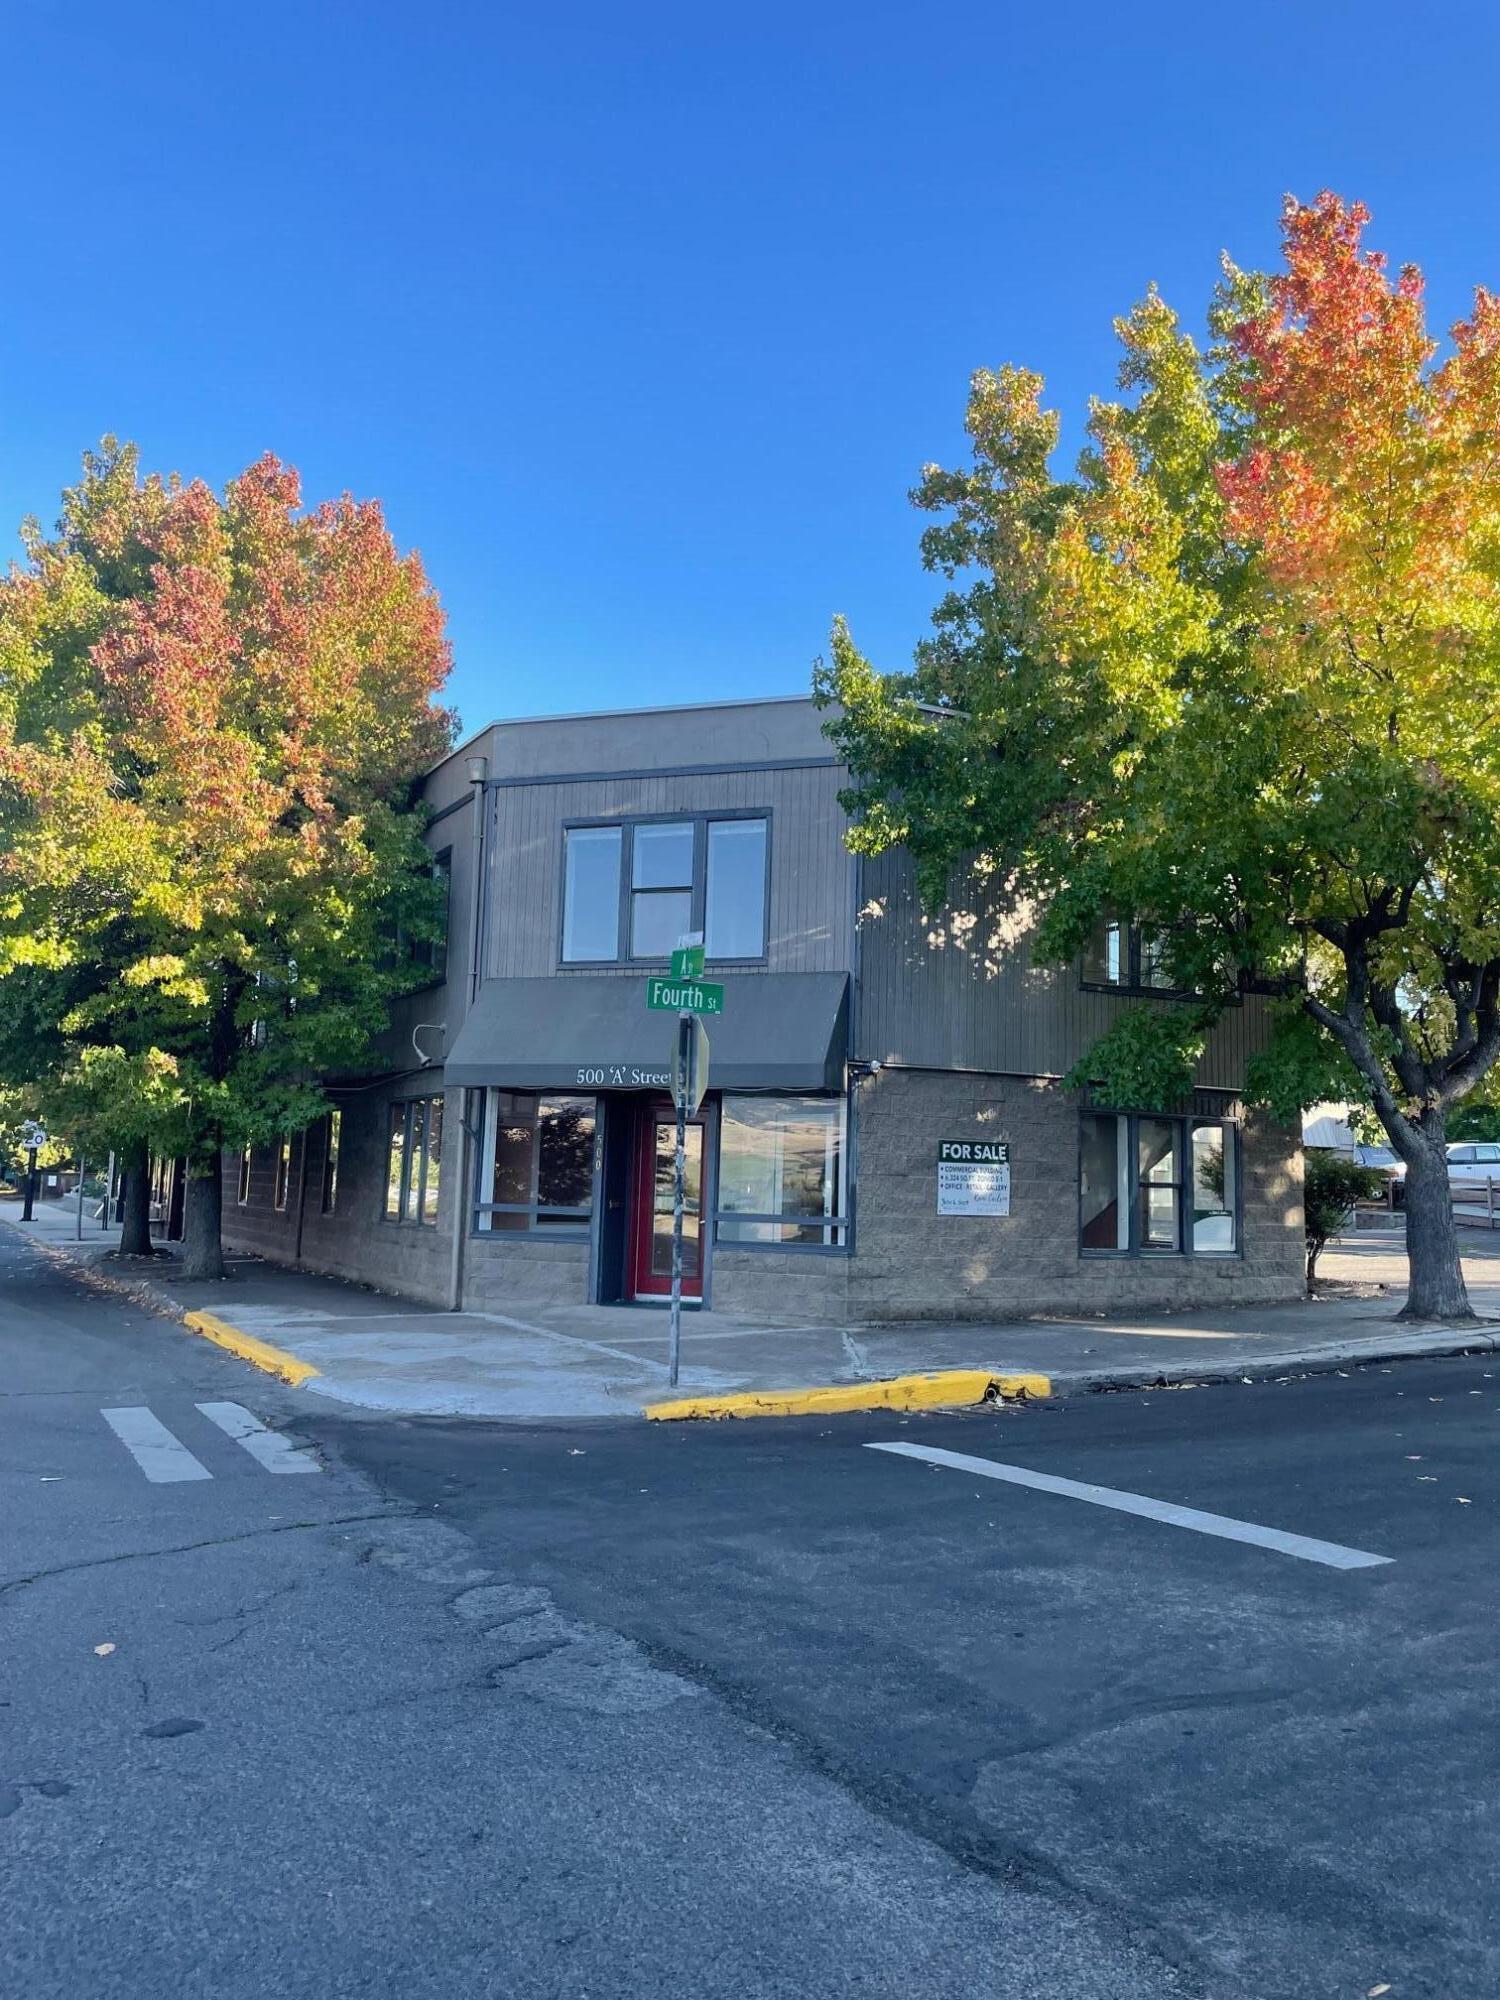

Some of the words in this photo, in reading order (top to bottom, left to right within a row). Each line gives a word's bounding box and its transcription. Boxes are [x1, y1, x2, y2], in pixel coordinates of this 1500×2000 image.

[680, 953, 687, 974] A
[653, 982, 703, 1008] Fourth
[707, 997, 717, 1009] St
[576, 1069, 604, 1084] 500
[942, 1143, 971, 1159] FOR
[974, 1145, 1007, 1161] SALE
